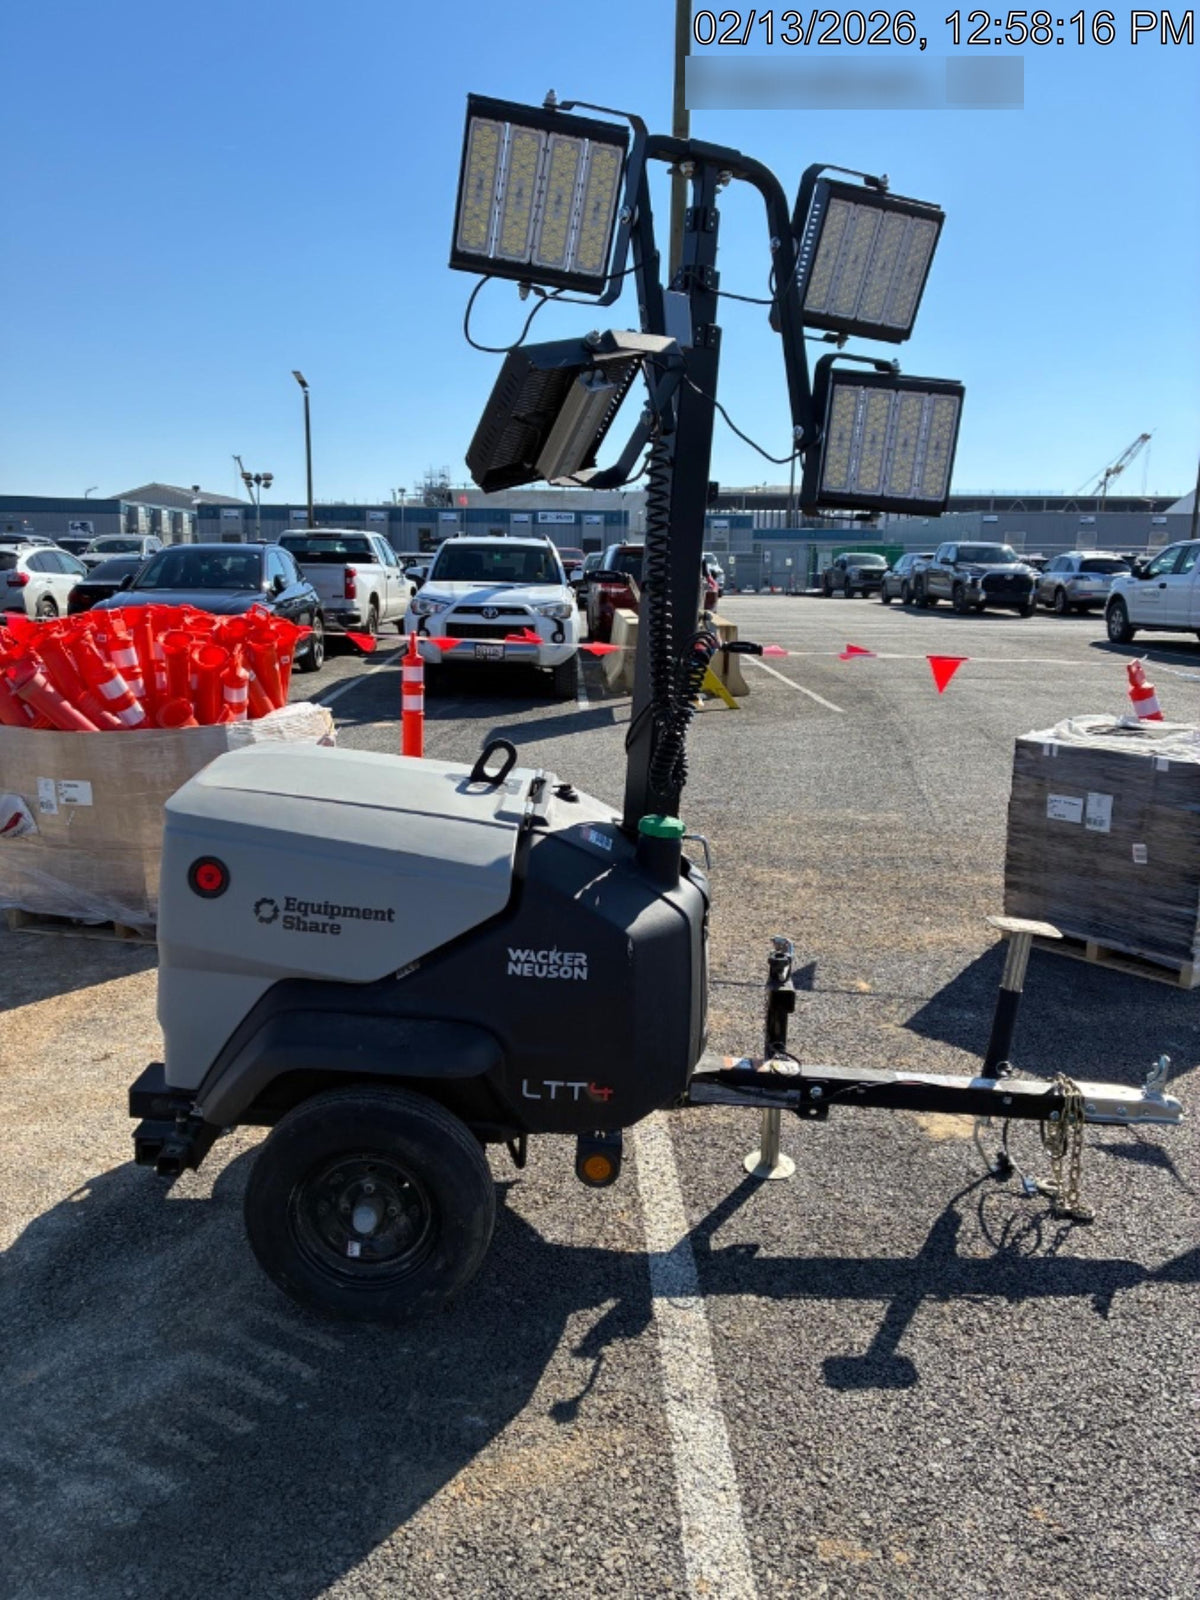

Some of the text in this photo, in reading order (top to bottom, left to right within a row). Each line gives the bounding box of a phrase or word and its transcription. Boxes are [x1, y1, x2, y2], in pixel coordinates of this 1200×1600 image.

[284, 896, 395, 922] Equipment
[282, 914, 342, 935] Share
[507, 945, 588, 967] WACKER
[507, 962, 588, 981] NEUSON
[522, 1079, 614, 1102] LTT4
